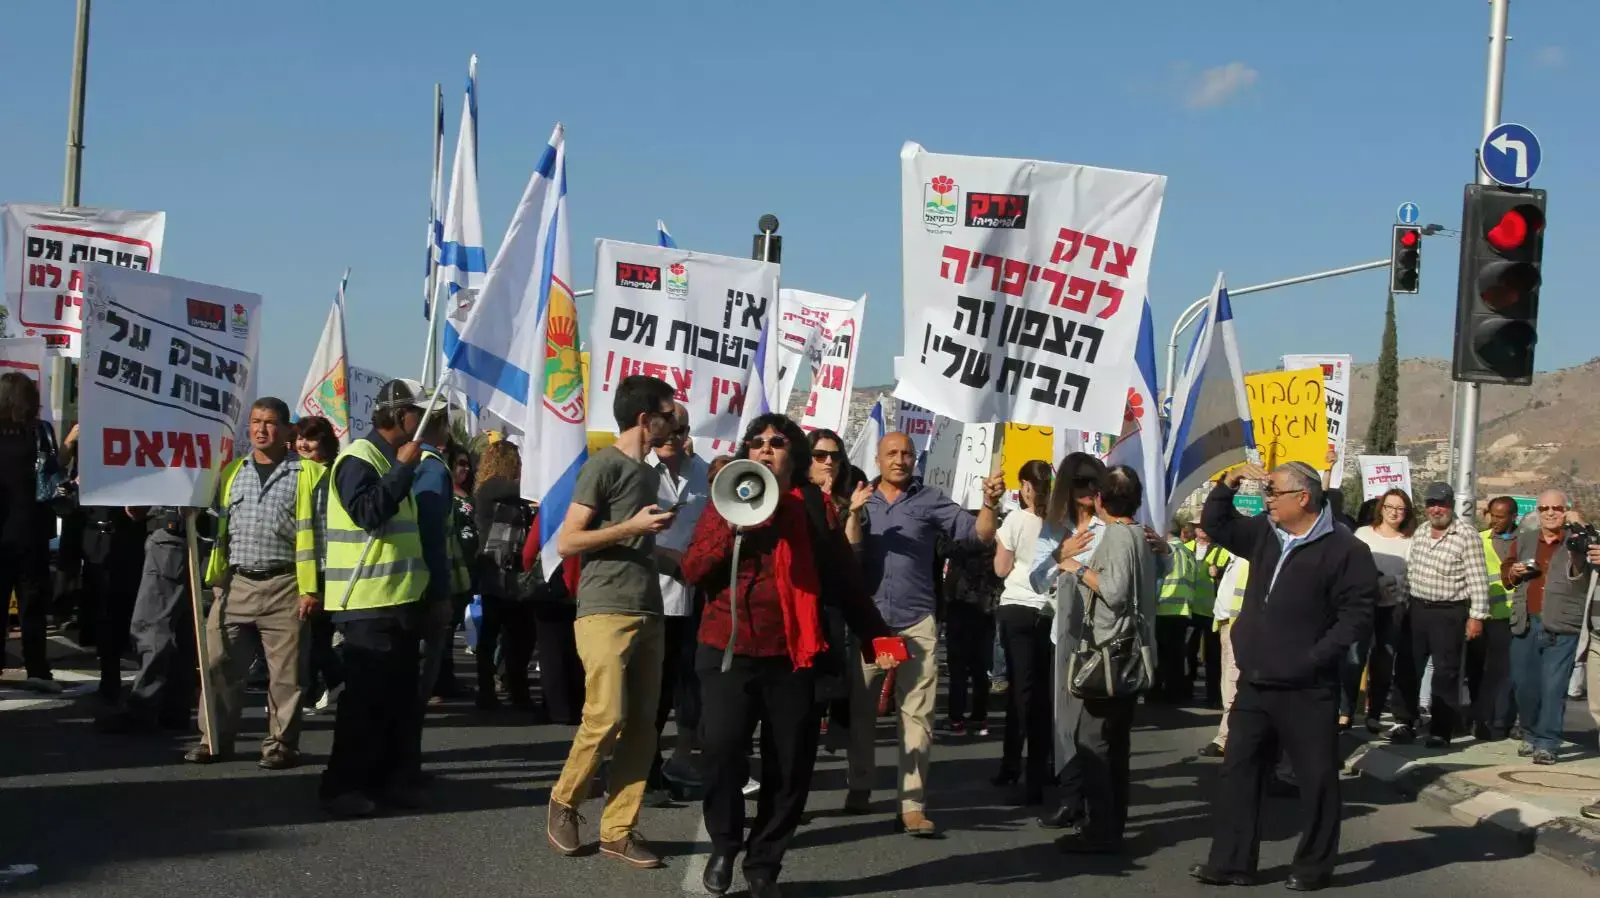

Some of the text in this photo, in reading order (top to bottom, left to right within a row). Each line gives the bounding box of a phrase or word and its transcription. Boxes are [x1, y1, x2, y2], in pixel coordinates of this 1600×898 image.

[925, 214, 954, 223] כרמיאל
[971, 194, 1024, 218] צדק
[972, 214, 1021, 227] לפריפריה!
[27, 236, 63, 261] מס
[1050, 227, 1138, 279] צדק
[29, 263, 62, 288] לנו
[619, 263, 657, 282] צדק
[940, 245, 1125, 319] לפריפריה
[723, 288, 767, 331] אין
[953, 295, 1105, 364] הצפון זה
[106, 310, 151, 351] על
[609, 306, 760, 370] הטבות מס
[97, 350, 162, 394] המס
[920, 322, 1090, 413] הבית שלי!
[709, 376, 748, 417] אין
[1253, 412, 1317, 439] מגיעו
[103, 427, 212, 469] נמאס
[1461, 500, 1473, 517] 2
